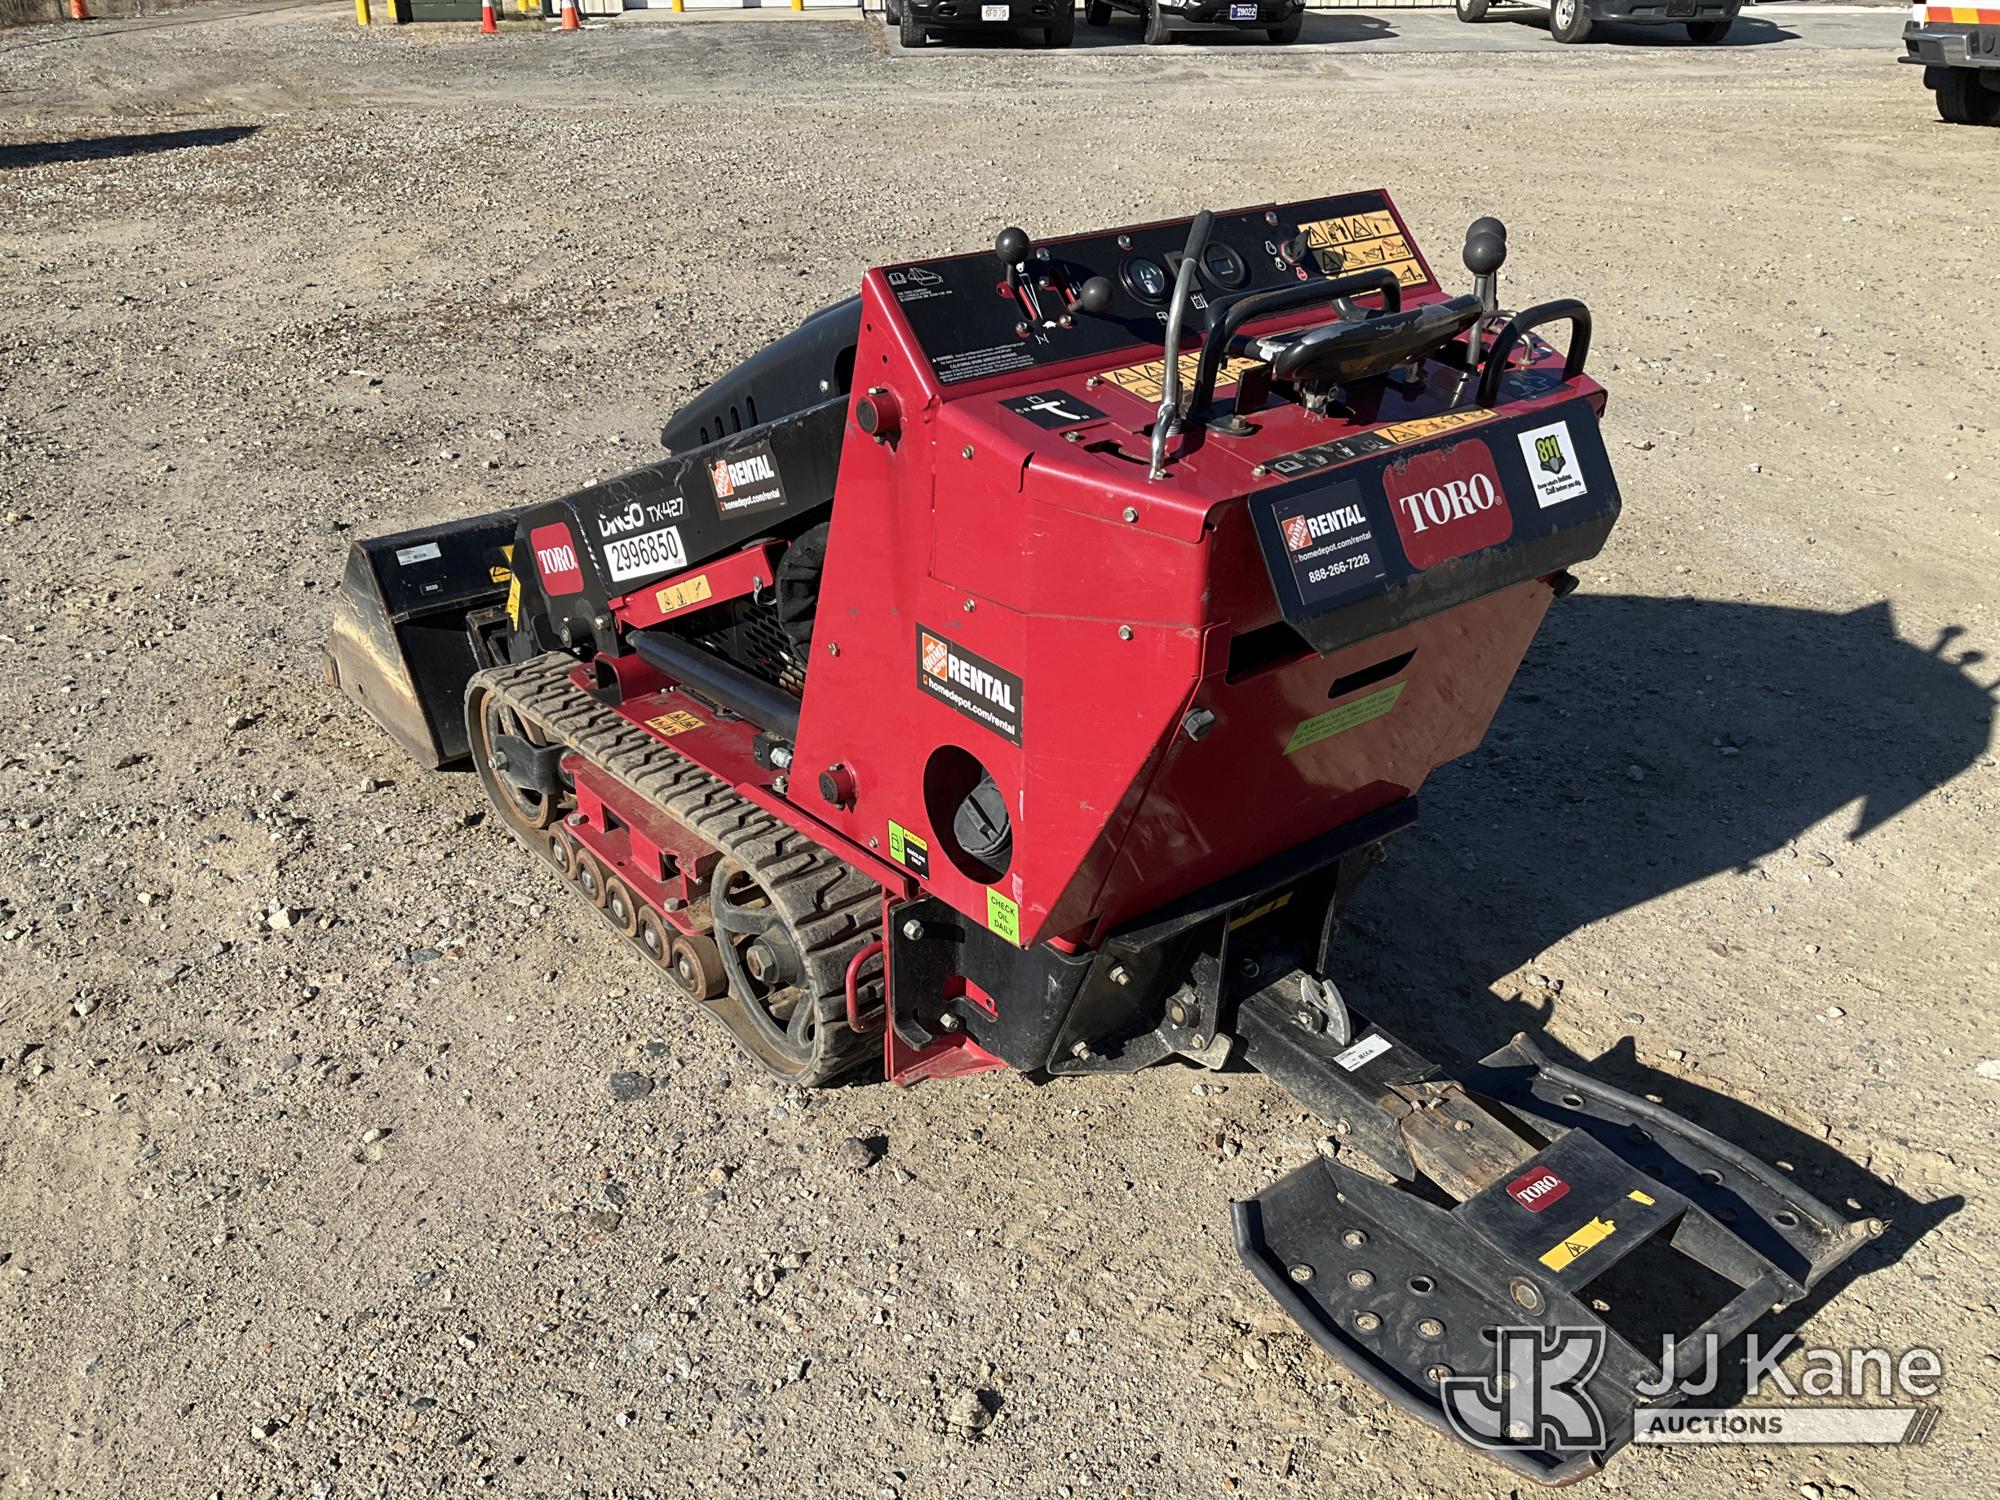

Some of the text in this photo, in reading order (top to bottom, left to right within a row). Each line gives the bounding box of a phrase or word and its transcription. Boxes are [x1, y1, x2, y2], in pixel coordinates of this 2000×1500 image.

[1535, 434, 1561, 463] 811
[728, 454, 775, 488] RENTAL
[724, 488, 780, 511] homedepot.com/rental
[1306, 504, 1366, 539] RENTAL
[612, 530, 678, 572] 2996850
[1298, 530, 1372, 562] homedepot.com/rental
[1308, 553, 1370, 584] 888-266-7228
[948, 653, 1015, 713] RENTAL
[928, 678, 1015, 735] homedepot.com/rental
[991, 896, 1015, 916] CHECK
[998, 911, 1009, 924] OIL
[994, 919, 1013, 936] DAILY
